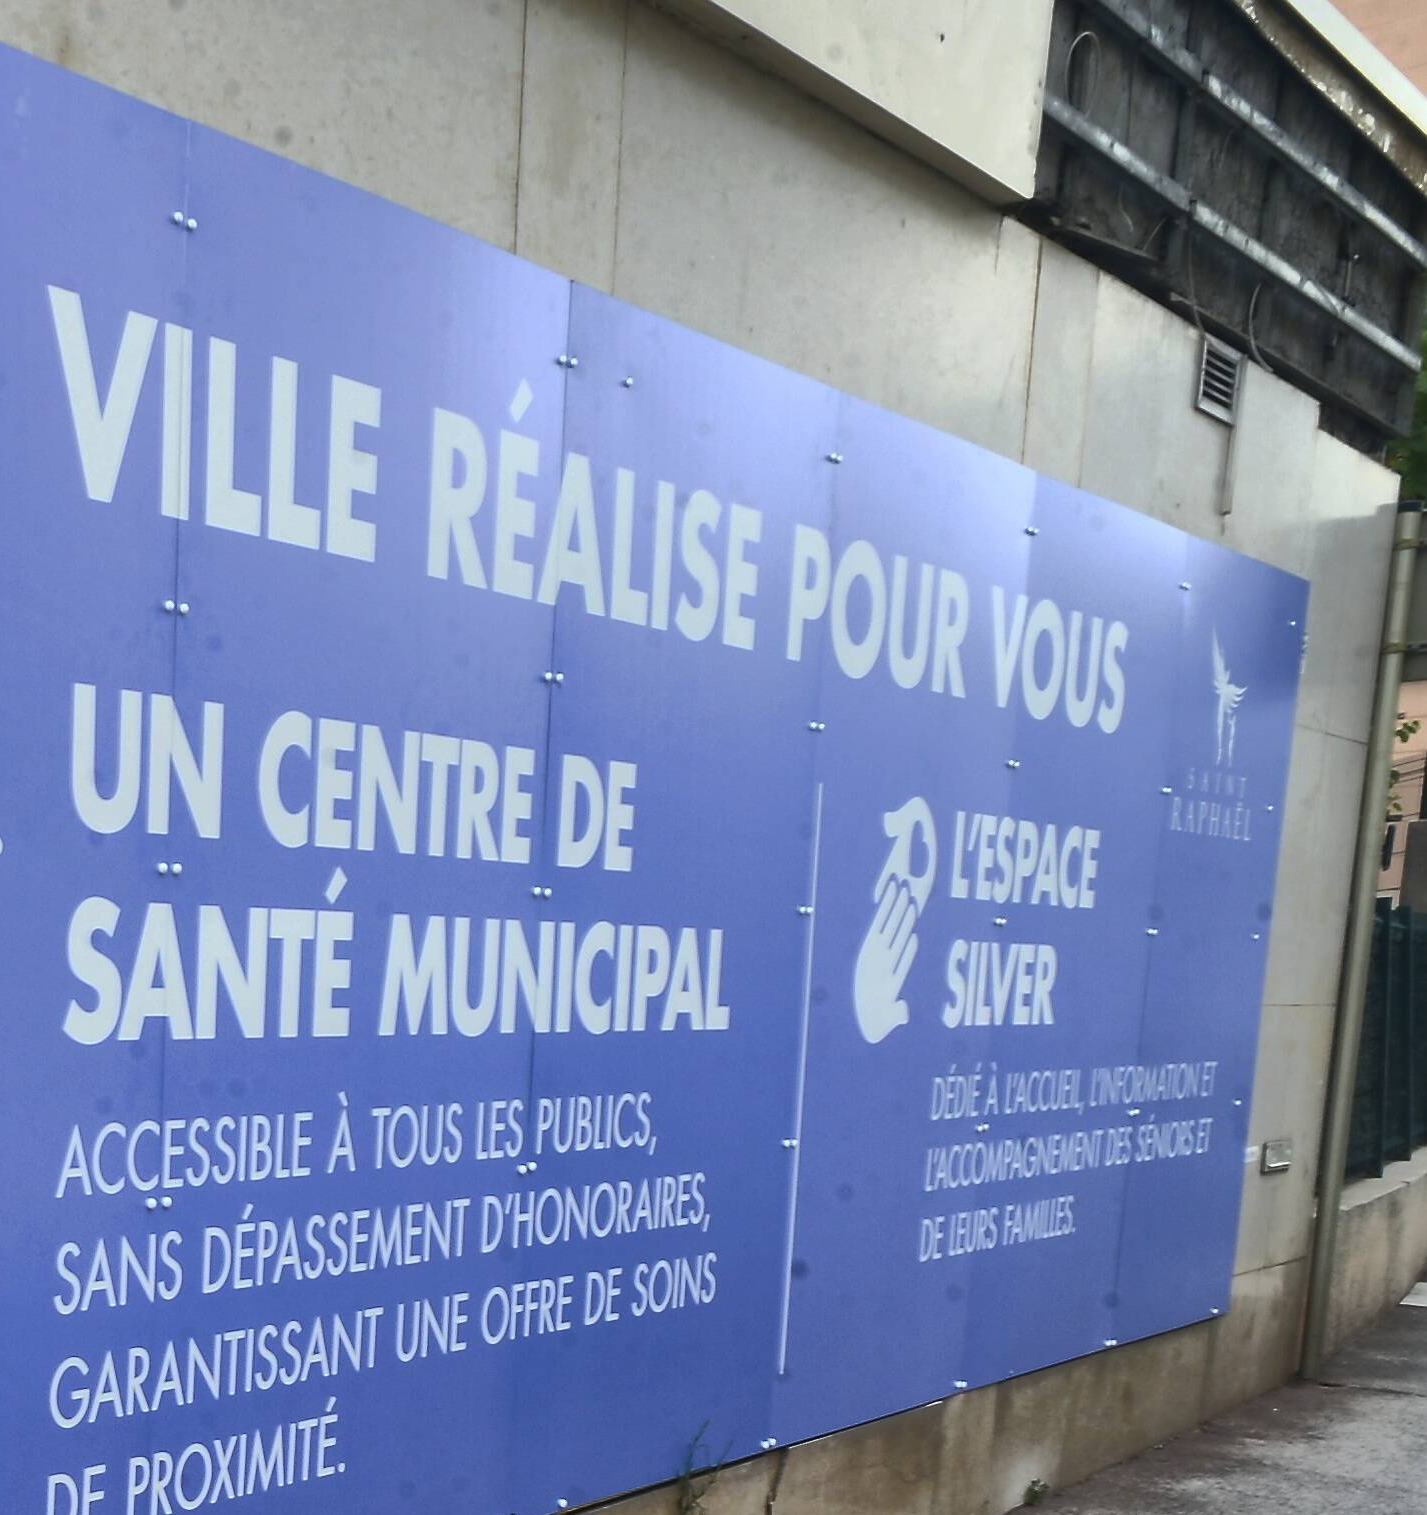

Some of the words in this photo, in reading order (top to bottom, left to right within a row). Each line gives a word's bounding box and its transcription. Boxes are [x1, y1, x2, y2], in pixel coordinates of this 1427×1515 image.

[46, 284, 381, 562] VILLE
[427, 378, 762, 650] RÉALISE
[787, 523, 969, 698] POUR
[992, 586, 1129, 733] VOUS
[71, 682, 224, 839] UN
[258, 710, 536, 864] CENTRE
[557, 754, 638, 872] DE
[951, 811, 1102, 909] L'ESPACE
[62, 866, 353, 1045] SANTÉ
[378, 913, 730, 1037] MUNICIPAL
[942, 938, 1057, 1028] SILVER
[929, 1062, 983, 1121] DÉDIÉ
[983, 1062, 999, 1115] À
[1090, 1062, 1196, 1107] L'INFORMATION
[1200, 1060, 1218, 1097] ET
[56, 1110, 313, 1198] ACCESSIBLE
[327, 1091, 356, 1174] À
[371, 1102, 463, 1169] TOUS
[476, 1098, 523, 1160] LES
[536, 1091, 658, 1156] PUBLICS,
[924, 1130, 1104, 1191] L'ACCOMPAGNEMENT
[1104, 1126, 1134, 1166] DES
[1135, 1114, 1195, 1162] SÉNIORS
[1195, 1118, 1214, 1154] ET
[53, 1230, 183, 1315] SANS
[201, 1203, 470, 1294] DÉPASSEMENT
[481, 1172, 712, 1254] D'HONORAIRES,
[919, 1216, 945, 1262] DE
[947, 1207, 999, 1256] LEURS
[1002, 1195, 1076, 1245] FAMILLES.
[48, 1306, 384, 1429] GARANTISSANT
[395, 1292, 469, 1362] UNE
[480, 1275, 575, 1346] OFFRE
[584, 1267, 622, 1325] DE
[631, 1252, 718, 1316] SOINS
